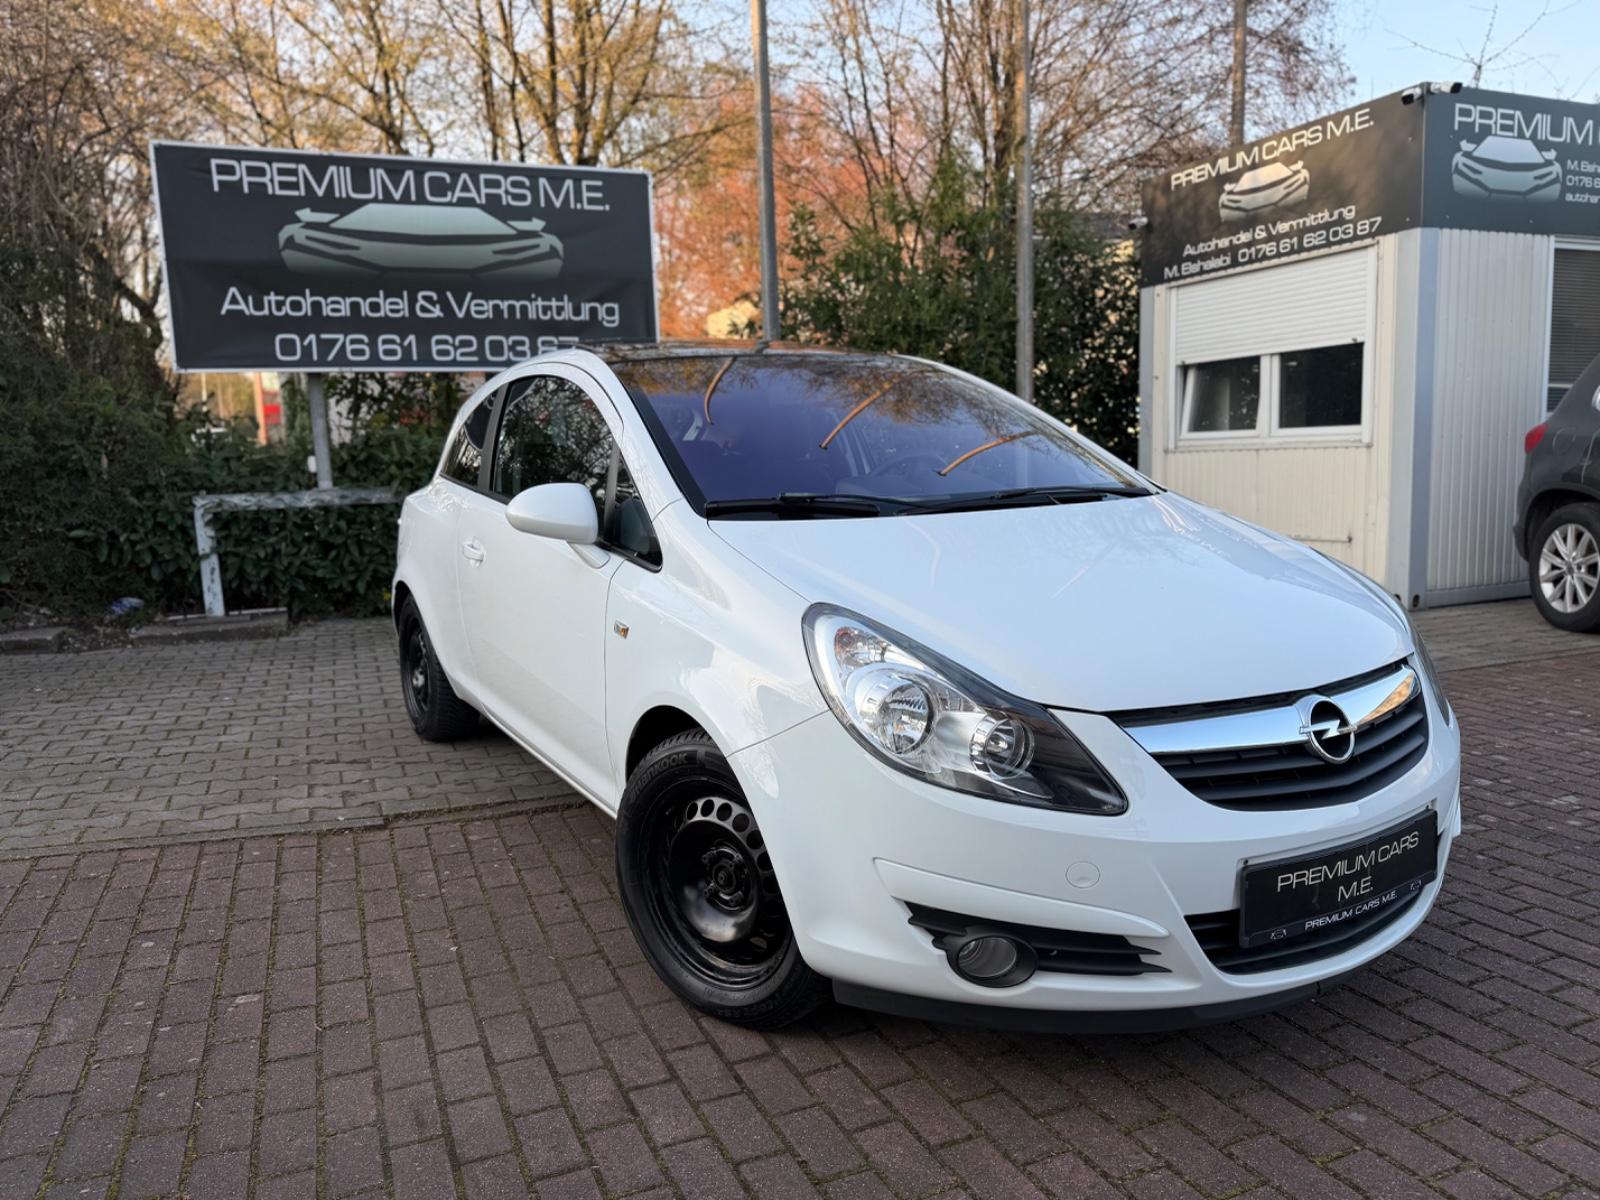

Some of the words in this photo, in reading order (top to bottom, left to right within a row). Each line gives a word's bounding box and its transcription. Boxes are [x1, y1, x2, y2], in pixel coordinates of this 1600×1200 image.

[1453, 102, 1594, 147] PREMIUM
[1170, 146, 1259, 192] PREMIUM
[1261, 125, 1323, 161] CARS
[1326, 108, 1375, 140] M.E.
[209, 157, 417, 203] PREMIUM
[423, 171, 532, 208] CARS
[538, 176, 611, 212] M.E.
[1182, 228, 1253, 257] Autohandel
[1254, 224, 1267, 240] &
[1268, 205, 1356, 235] Vermittlung
[1237, 241, 1277, 263] 0176
[1279, 237, 1298, 253] 61
[1303, 229, 1327, 248] 62
[1329, 223, 1354, 242] 03
[1356, 215, 1382, 236] 87
[219, 286, 410, 319] Autohandel
[413, 290, 444, 320] &
[448, 291, 620, 328] Vermittlung
[274, 332, 371, 363] 0176
[377, 333, 418, 362] 61
[430, 334, 479, 362] 62
[484, 335, 531, 362] 03
[1276, 849, 1376, 893] PREMIUM
[1377, 831, 1420, 863] CARS
[1337, 875, 1374, 902] M.E.
[1304, 909, 1353, 931] PREMIUM
[1355, 897, 1380, 915] CARS
